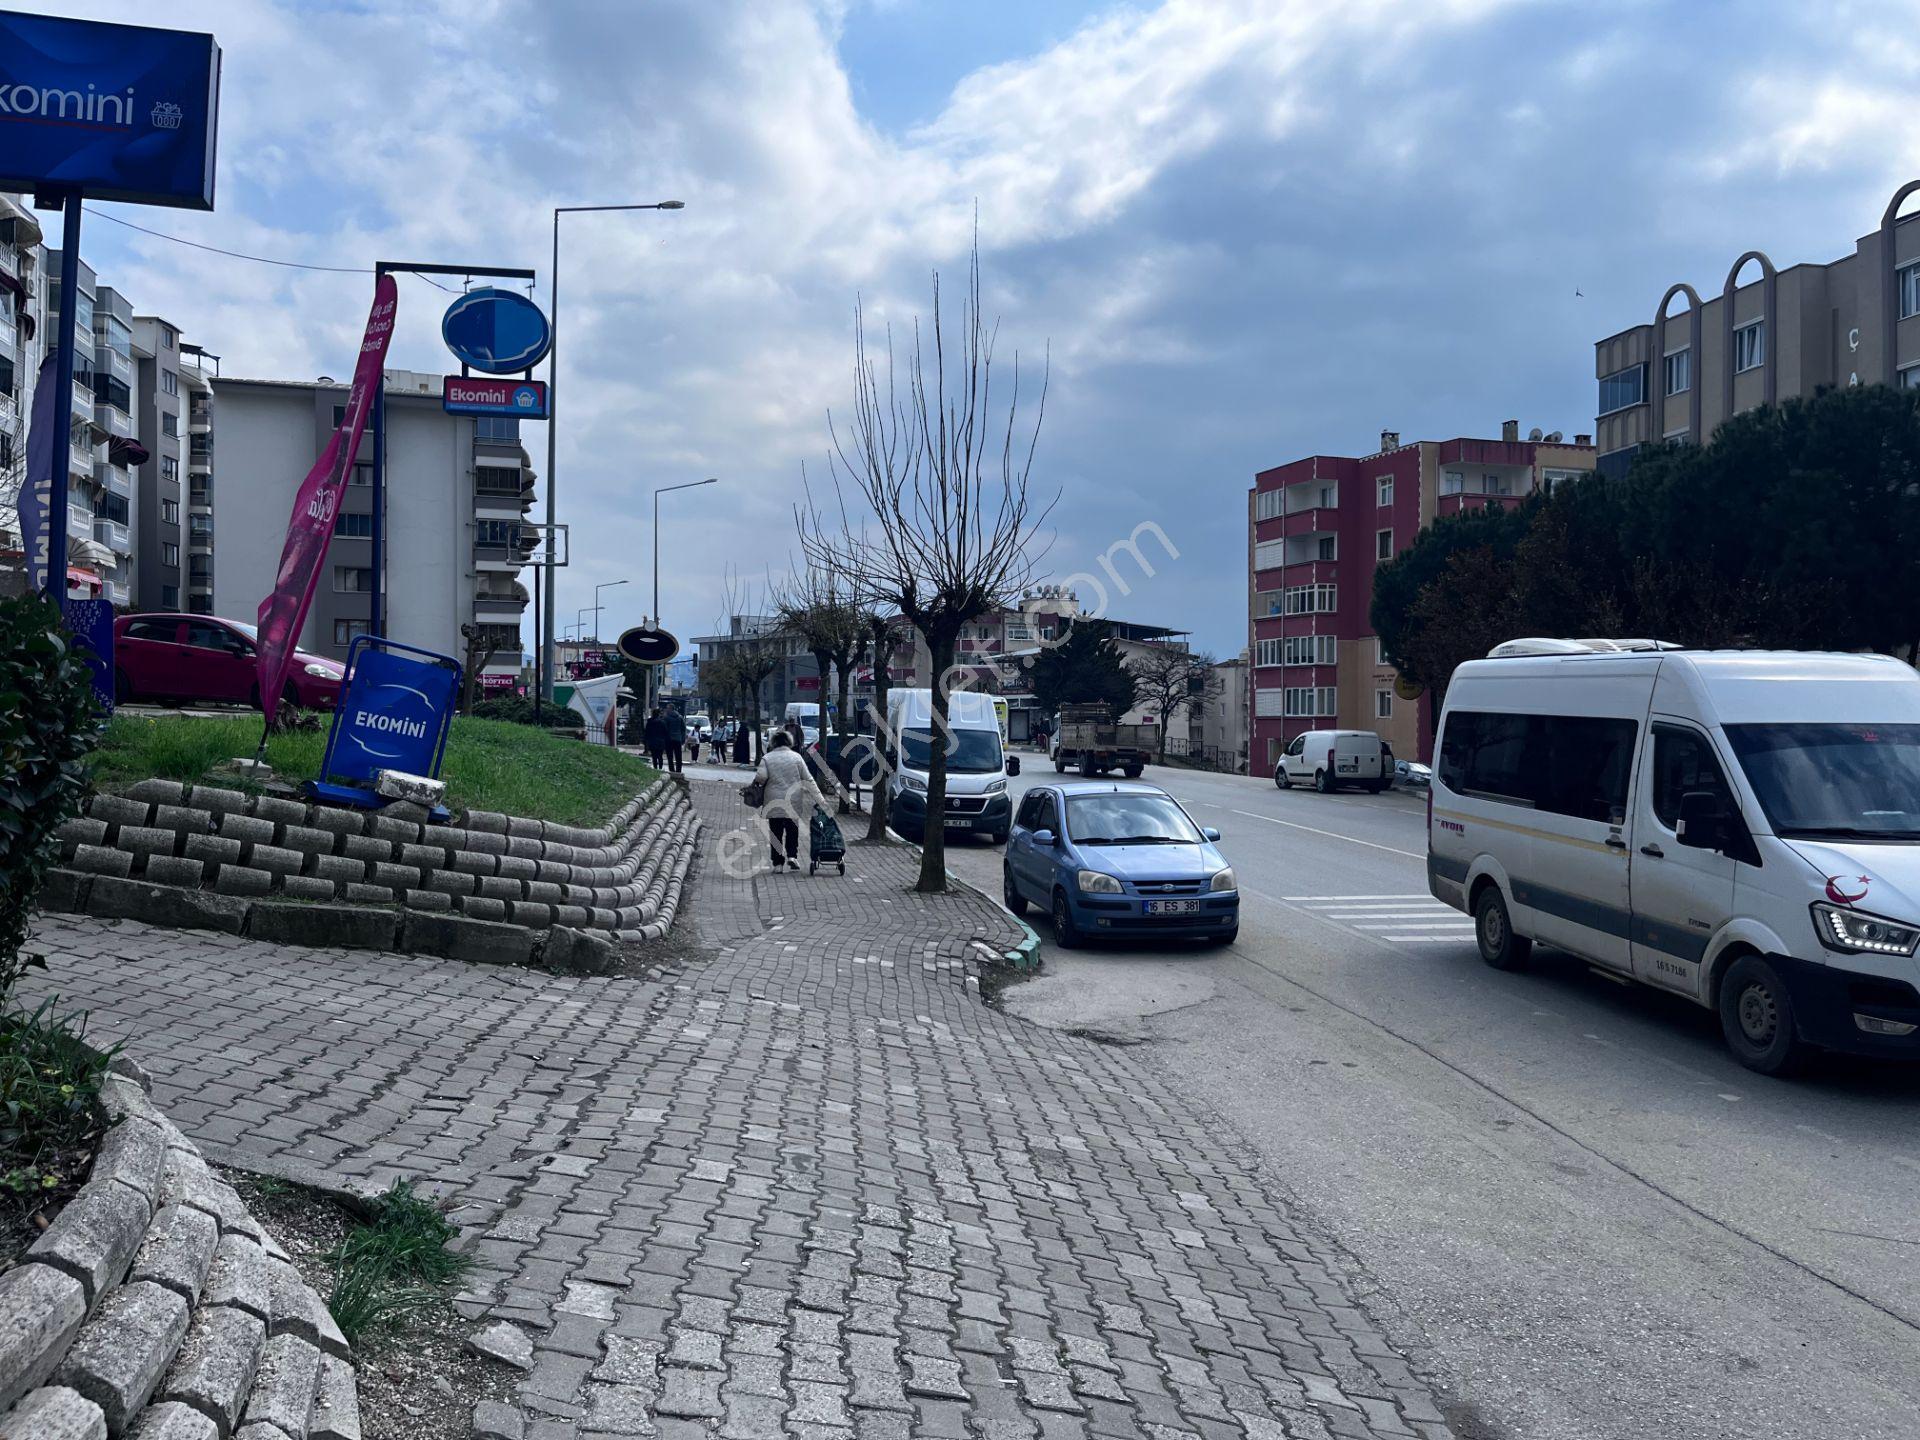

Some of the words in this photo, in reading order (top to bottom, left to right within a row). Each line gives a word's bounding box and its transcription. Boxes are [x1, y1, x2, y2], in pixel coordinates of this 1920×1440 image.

[450, 388, 506, 403] Ekomini
[1149, 901, 1158, 911] 16
[1164, 902, 1178, 911] ES
[1184, 900, 1198, 911] 381
